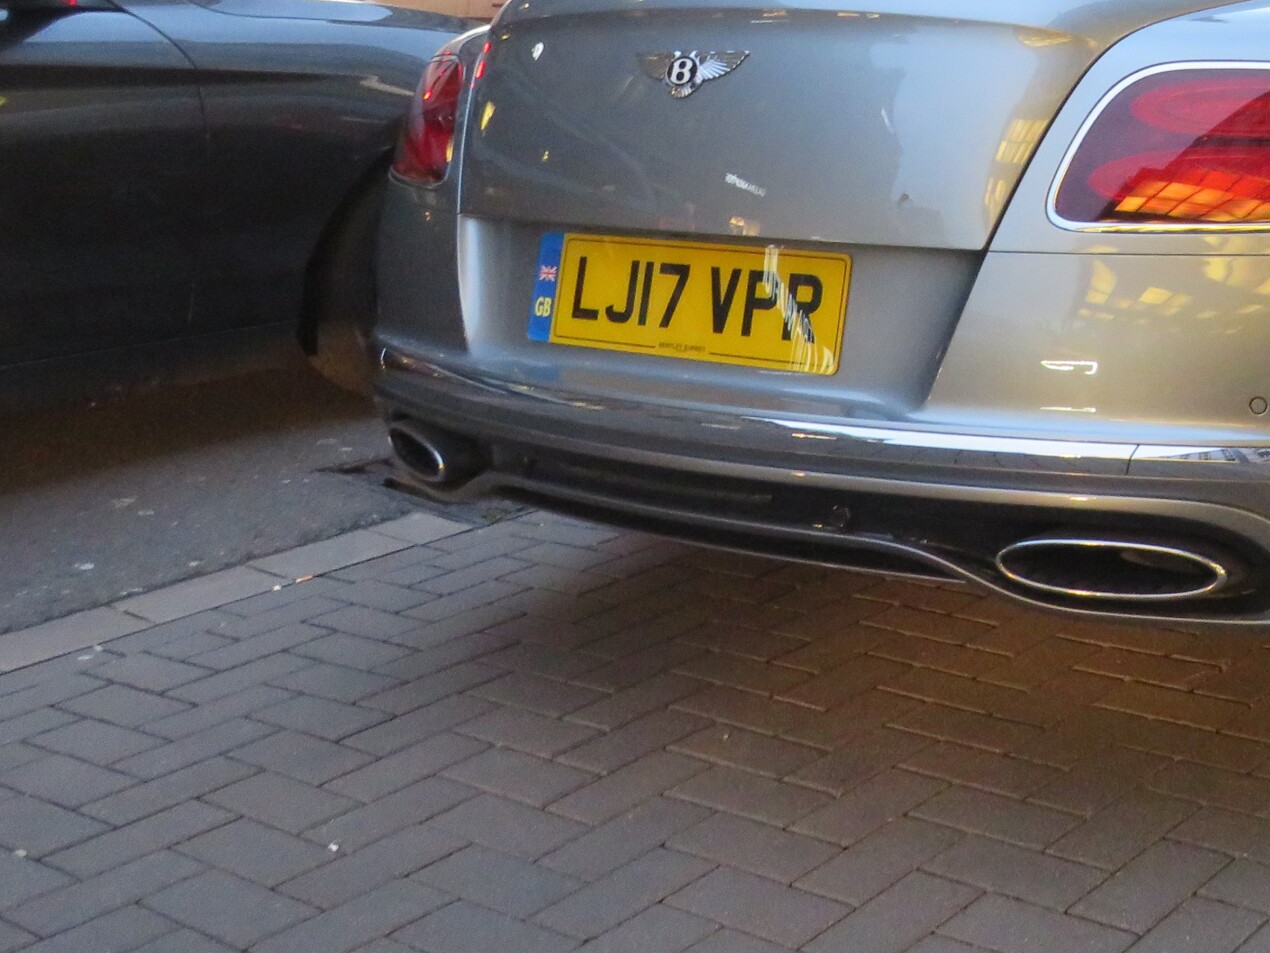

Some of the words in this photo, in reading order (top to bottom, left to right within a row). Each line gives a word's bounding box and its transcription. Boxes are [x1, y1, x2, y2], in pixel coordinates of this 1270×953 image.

[535, 296, 552, 317] GB
[571, 256, 691, 329] LJ17
[711, 266, 823, 344] VPR
